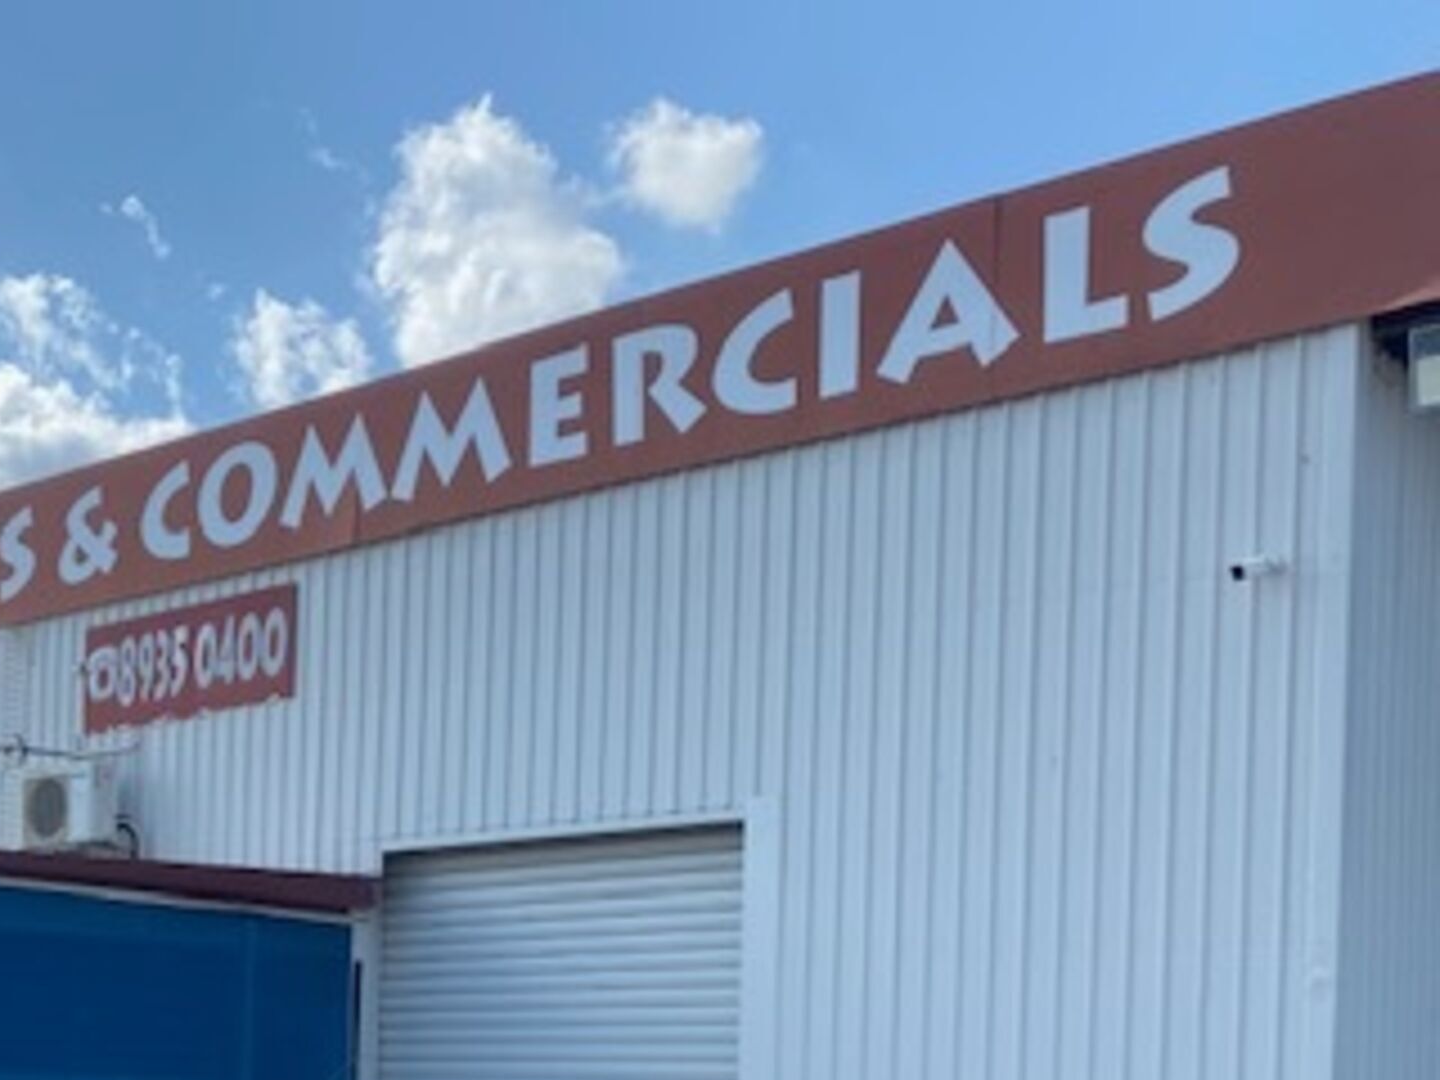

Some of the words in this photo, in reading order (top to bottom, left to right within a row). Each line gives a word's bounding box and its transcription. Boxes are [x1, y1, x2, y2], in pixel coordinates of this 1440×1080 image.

[58, 485, 118, 586] &
[140, 165, 1241, 560] COMMERCIALS
[116, 624, 190, 707] 8935
[194, 607, 287, 689] 0400
